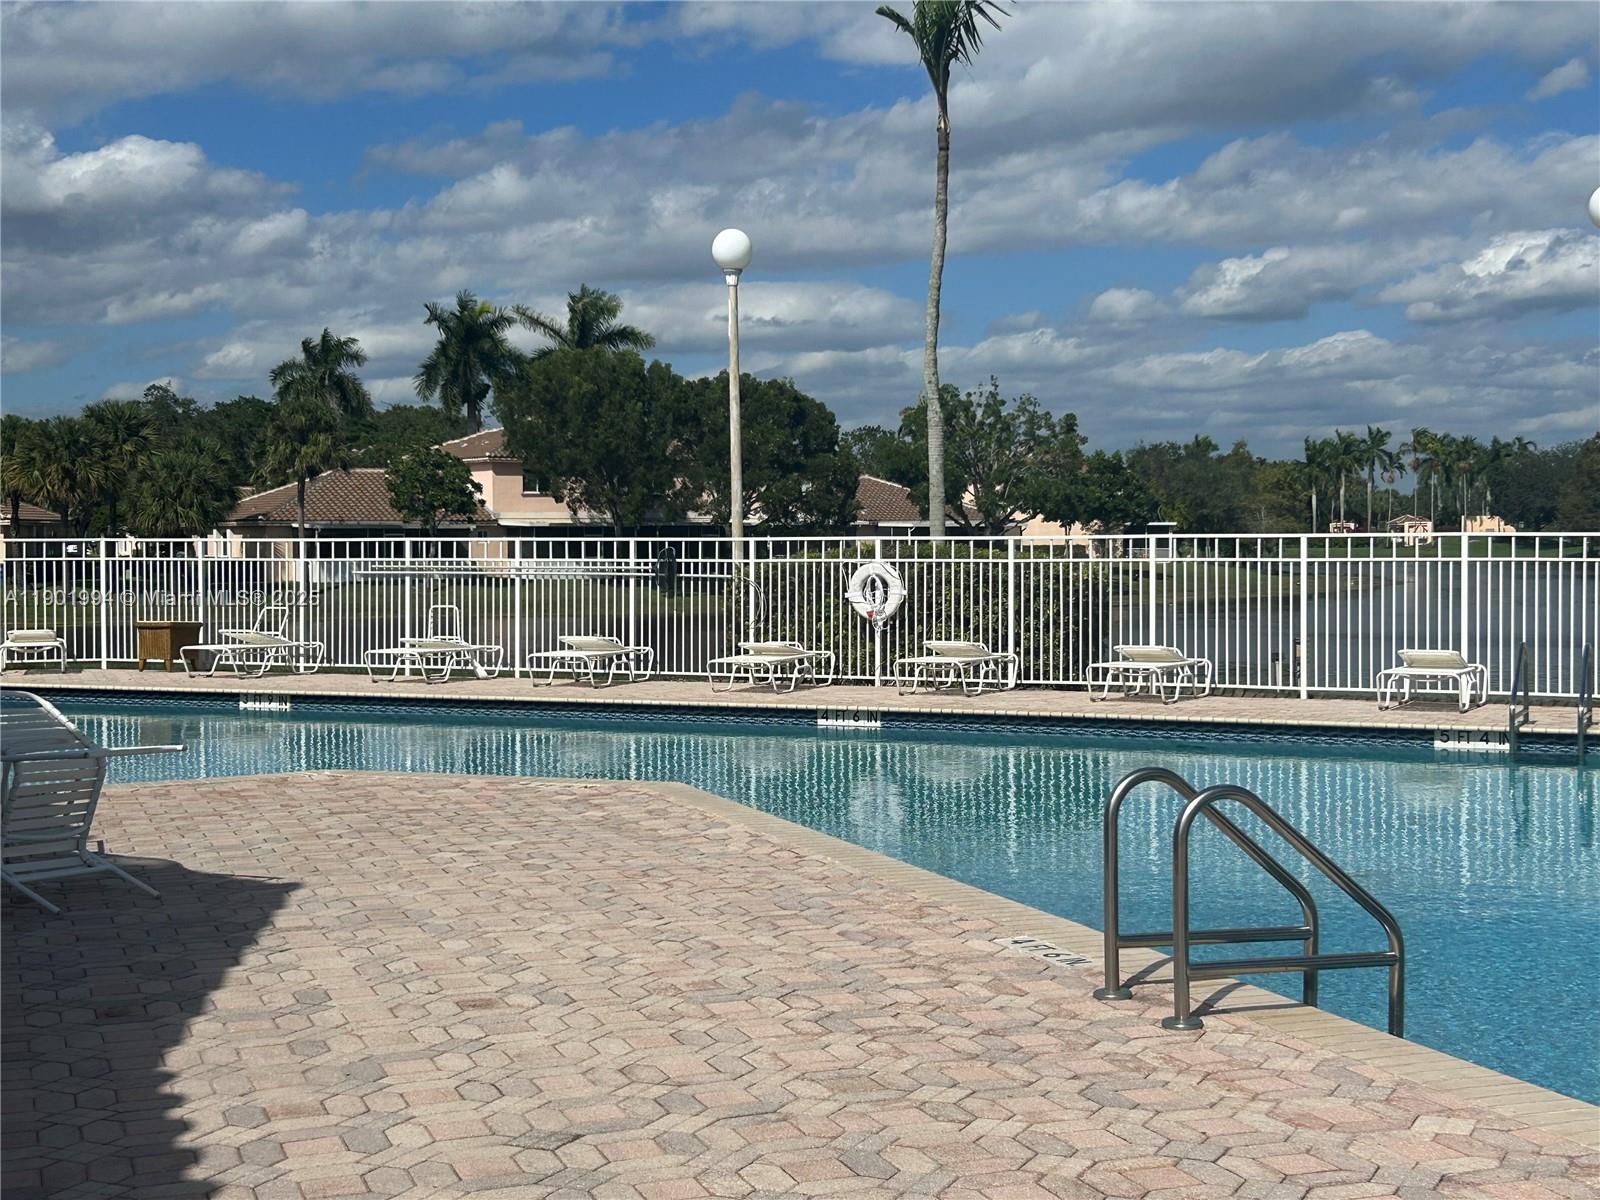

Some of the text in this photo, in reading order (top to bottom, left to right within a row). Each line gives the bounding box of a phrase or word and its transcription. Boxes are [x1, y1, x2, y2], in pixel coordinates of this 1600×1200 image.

[253, 694, 262, 705] FT
[278, 695, 288, 706] IN
[821, 709, 878, 723] 4 FT 6 IN
[1439, 730, 1450, 743] 5
[1457, 731, 1472, 744] FT
[1480, 731, 1490, 744] 4
